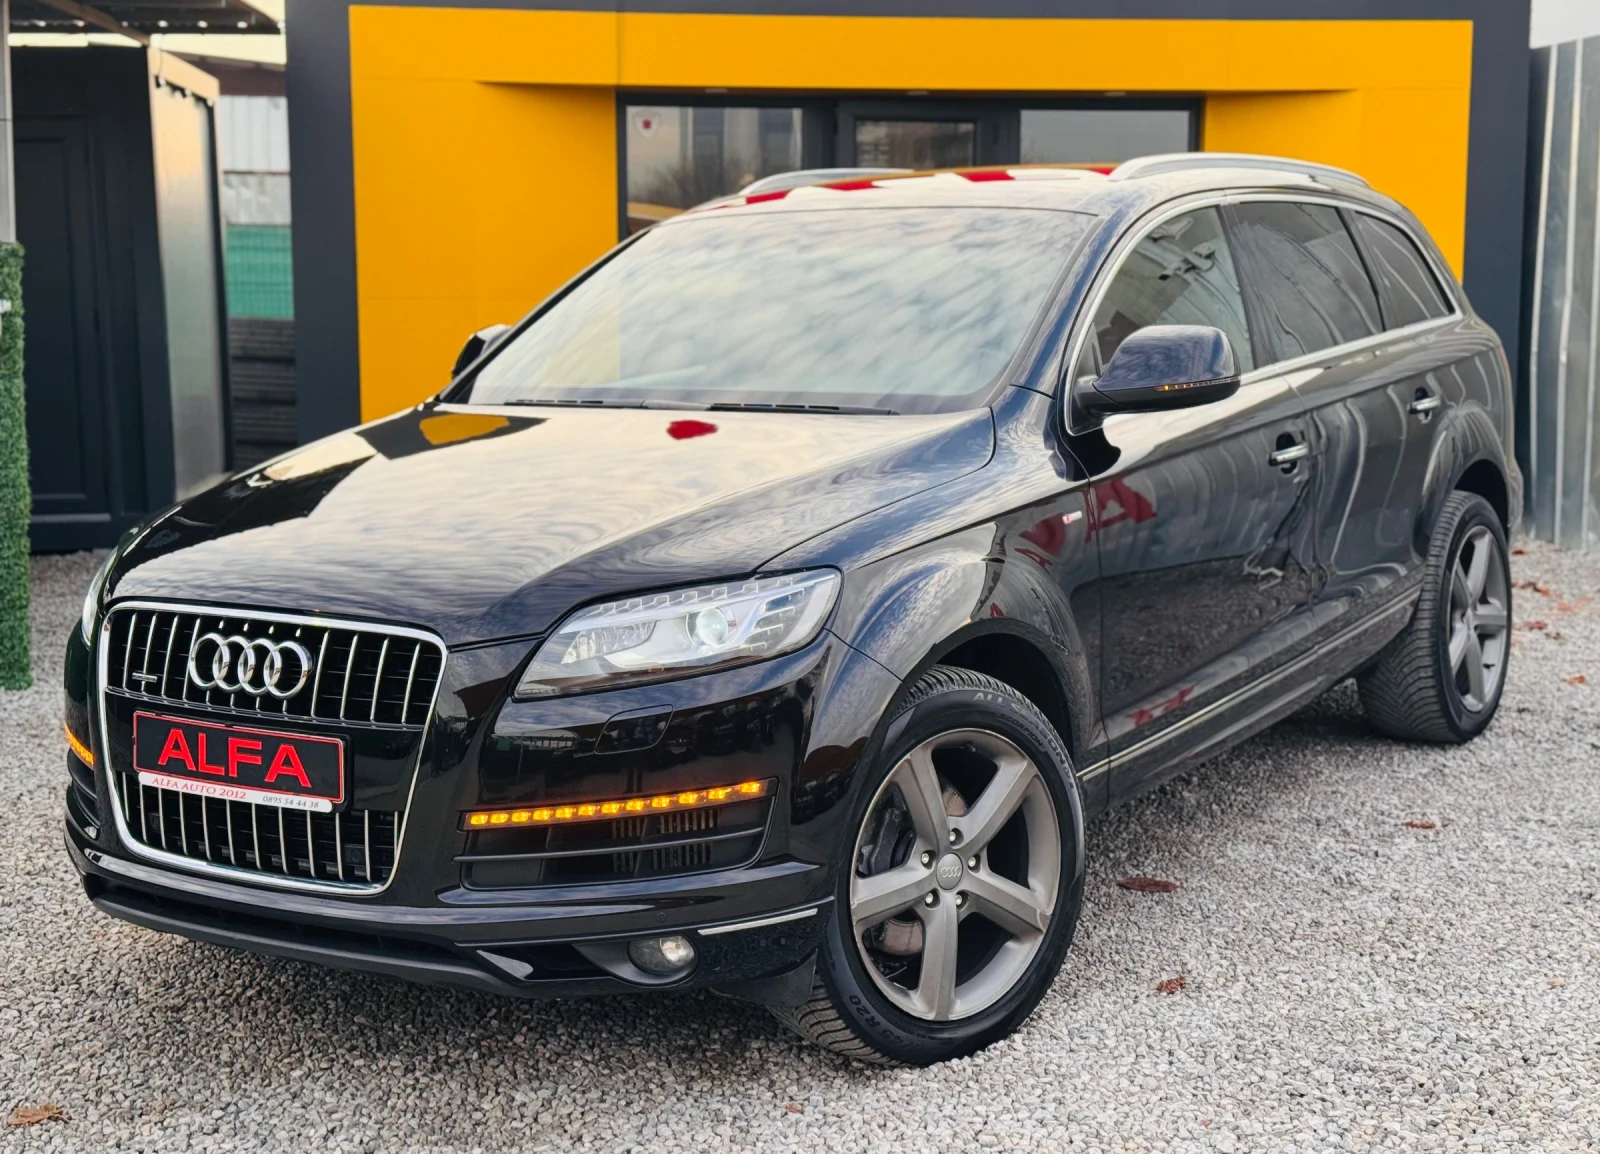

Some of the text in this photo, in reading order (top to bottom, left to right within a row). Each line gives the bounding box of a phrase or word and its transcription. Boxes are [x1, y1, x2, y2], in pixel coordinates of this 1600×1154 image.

[973, 692, 1067, 766] ALL SEASON
[1000, 713, 1045, 748] SCORPION
[157, 727, 313, 788] ALFA
[152, 777, 247, 800] ALFA AUTO 2012
[262, 795, 282, 805] 0895
[296, 800, 307, 808] 44
[308, 801, 319, 809] 38
[849, 995, 881, 1027] R20
